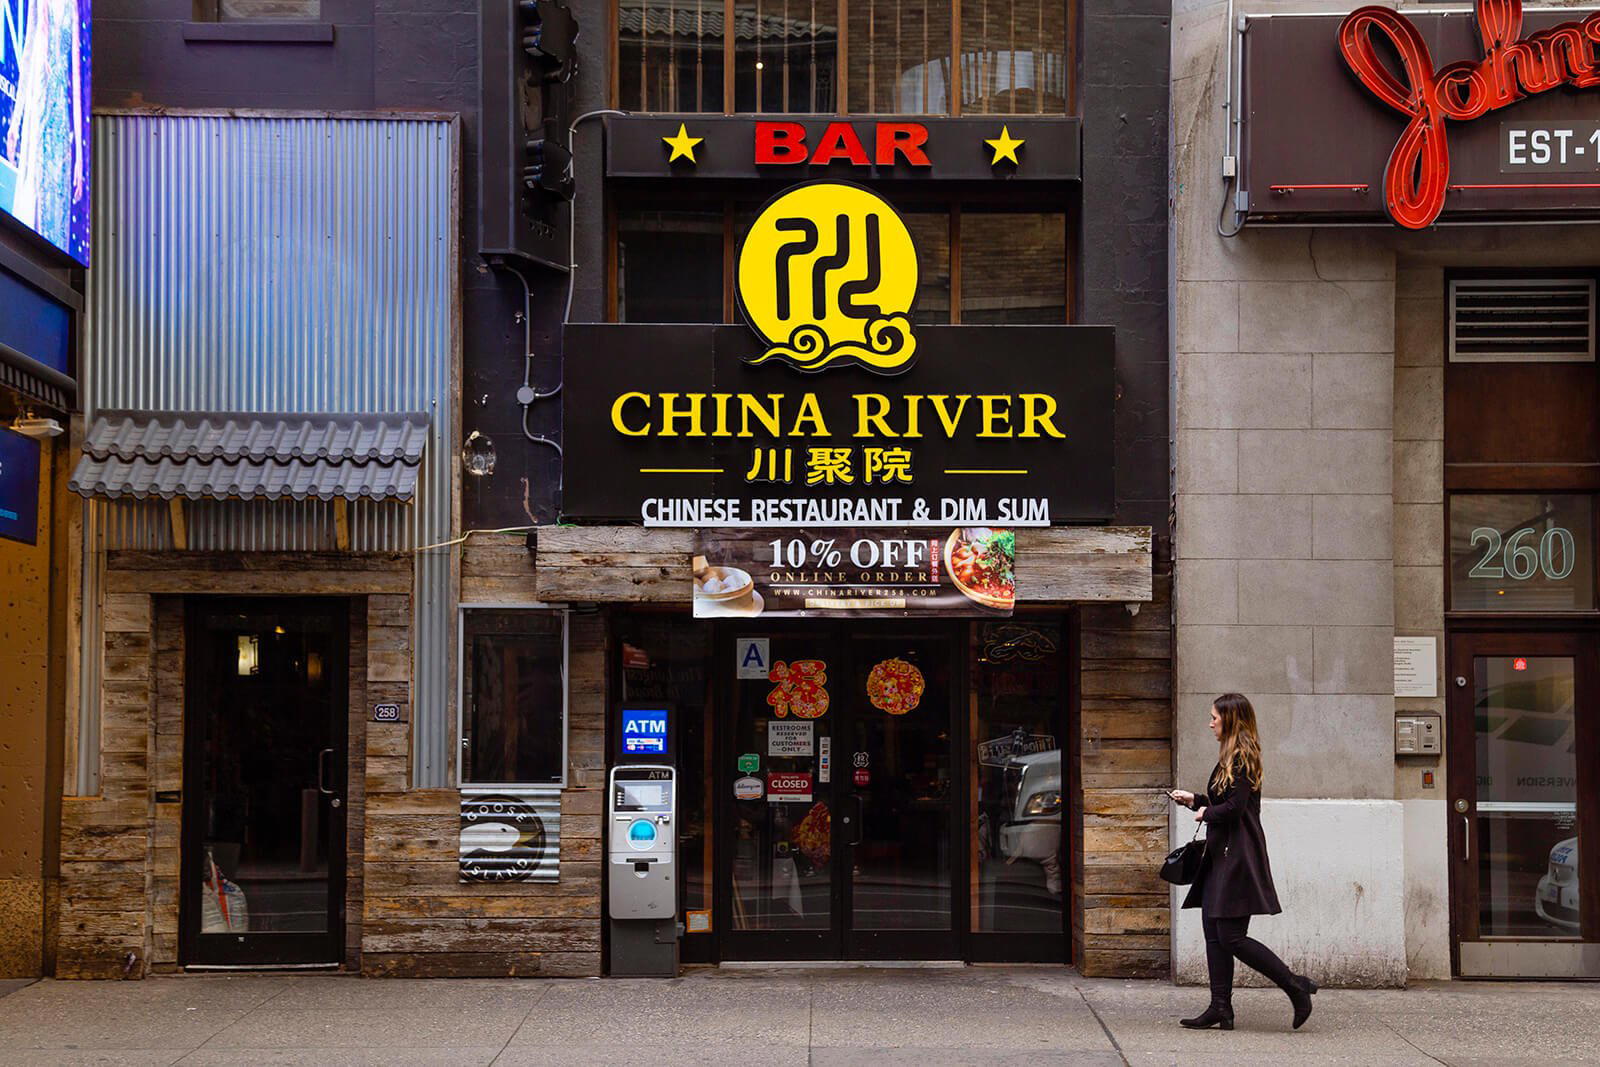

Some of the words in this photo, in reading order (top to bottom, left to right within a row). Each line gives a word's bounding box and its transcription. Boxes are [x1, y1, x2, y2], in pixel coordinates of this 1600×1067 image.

[754, 121, 932, 167] BAR
[610, 391, 832, 439] CHINA
[852, 392, 1067, 439] RIVER
[745, 446, 914, 485] 川聚院
[640, 497, 741, 523] CHINESE
[751, 498, 903, 523] RESTAURANT
[911, 498, 931, 522] &
[939, 498, 987, 523] DIM
[998, 498, 1050, 523] SUM
[769, 538, 841, 569] 10%
[850, 538, 928, 569] OFF
[1469, 526, 1576, 580] 260
[770, 571, 847, 582] ONLINE
[861, 571, 927, 582] ORDER
[773, 589, 937, 597] WWW.CHINARIVER258.COM
[742, 642, 764, 667] A
[377, 708, 396, 718] 258
[624, 719, 666, 734] ATM
[648, 771, 670, 779] ATM
[771, 779, 809, 789] CLOSED
[466, 802, 528, 823] GOOSE
[463, 858, 529, 881] ISLAND
